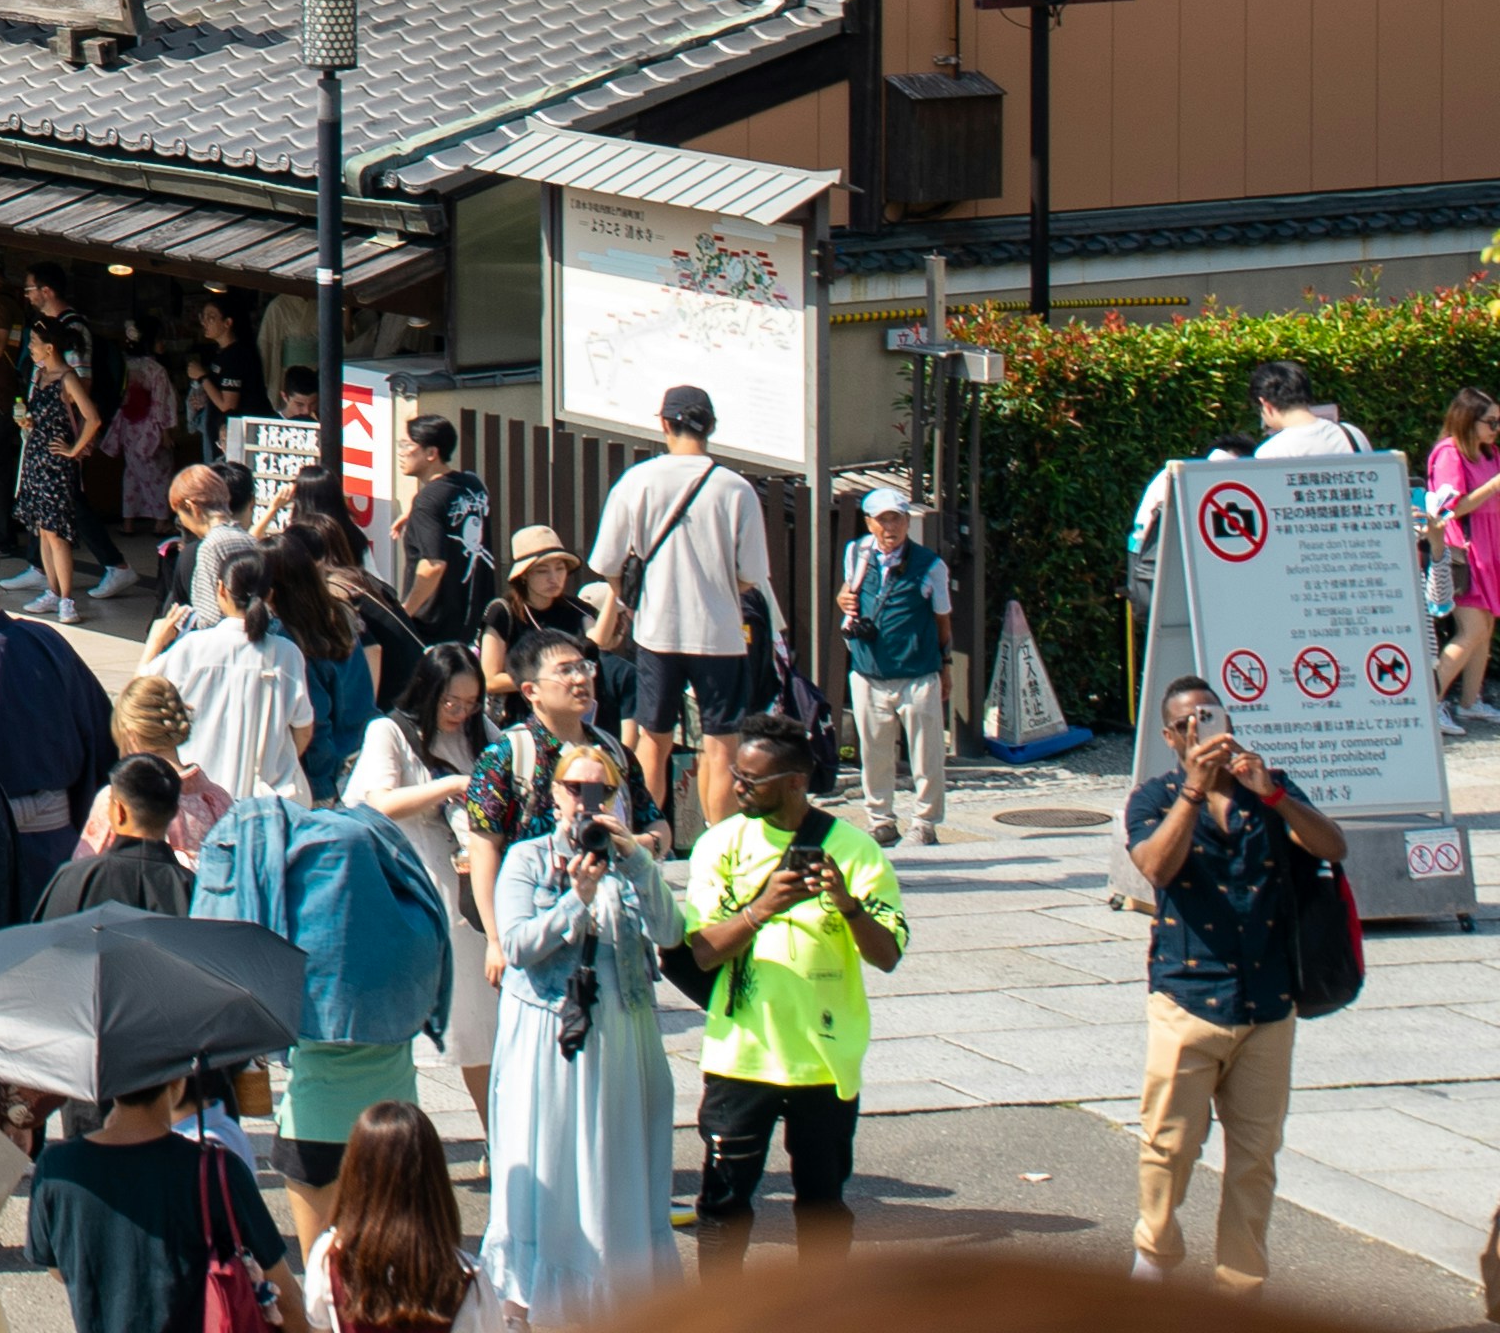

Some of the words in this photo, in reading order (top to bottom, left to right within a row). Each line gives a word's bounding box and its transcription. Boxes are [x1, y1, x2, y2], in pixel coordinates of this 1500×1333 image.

[1285, 470, 1379, 486] 正面階段付近での
[1292, 487, 1374, 503] 集合写真撮影は
[1298, 540, 1324, 550] Please
[1326, 540, 1347, 549] don't
[1348, 539, 1366, 549] take
[1367, 539, 1381, 548] the
[1300, 553, 1329, 563] picture
[1019, 644, 1044, 716] 立入禁止
[1251, 737, 1298, 753] Shooting
[1300, 737, 1315, 749] for
[1318, 739, 1338, 751] any
[1341, 735, 1403, 748] commercial
[1269, 754, 1318, 768] purposes
[1320, 752, 1329, 764] is
[1331, 749, 1386, 767] prohibited
[1310, 784, 1351, 802] 清水寺
